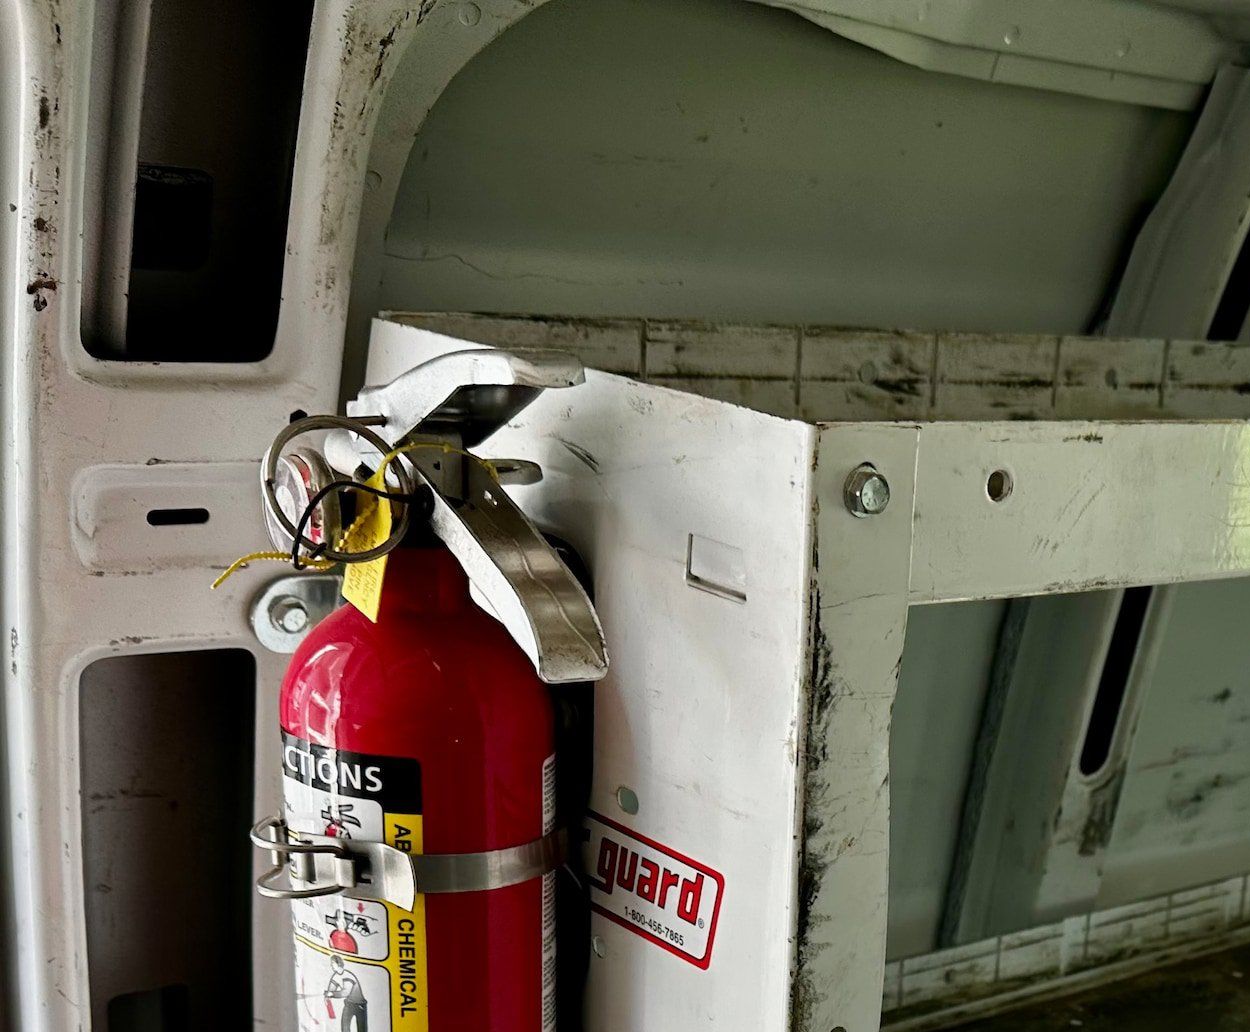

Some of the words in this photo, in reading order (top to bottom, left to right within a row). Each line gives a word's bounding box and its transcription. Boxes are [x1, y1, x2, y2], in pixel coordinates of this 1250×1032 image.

[284, 745, 383, 792] CTIONS
[394, 824, 411, 852] AB
[624, 906, 684, 946] 1-800-456-7865
[397, 919, 417, 1018] CHEMICAL
